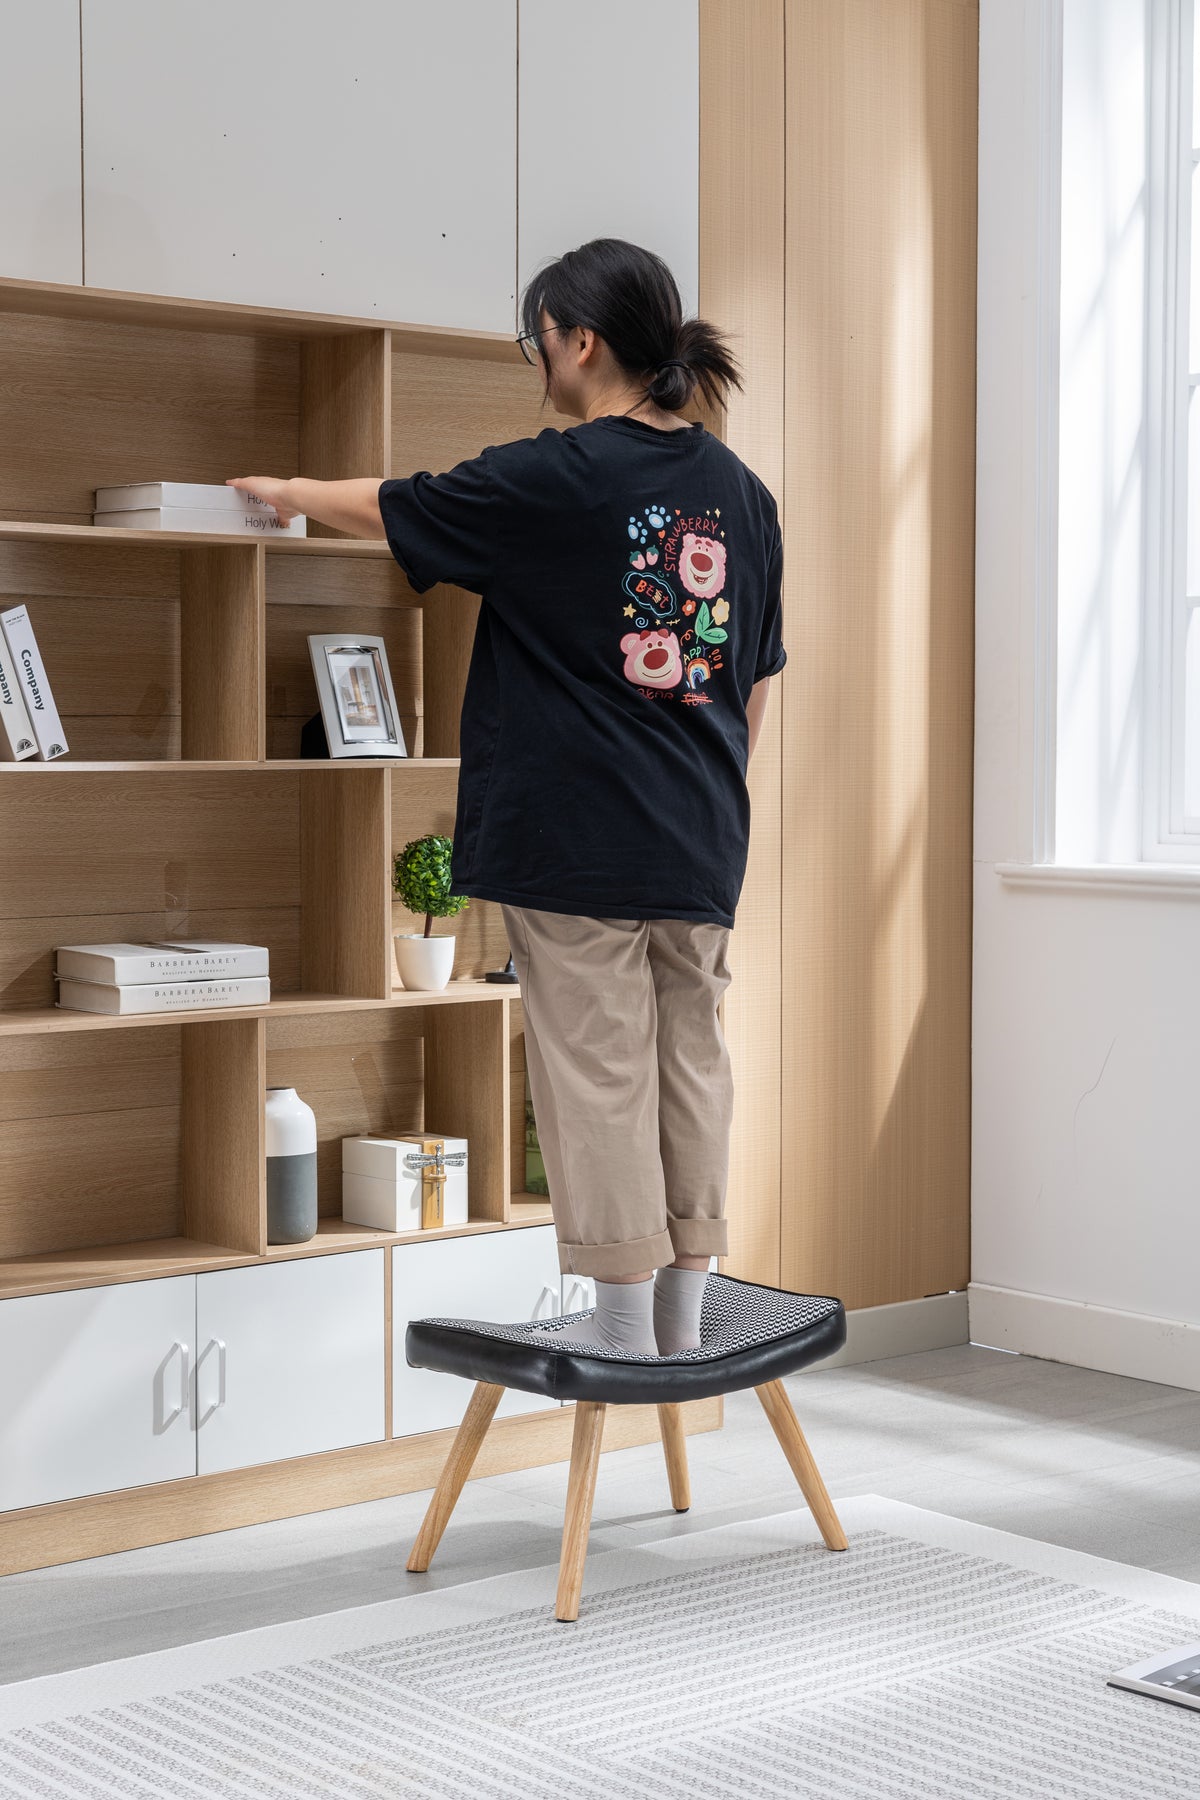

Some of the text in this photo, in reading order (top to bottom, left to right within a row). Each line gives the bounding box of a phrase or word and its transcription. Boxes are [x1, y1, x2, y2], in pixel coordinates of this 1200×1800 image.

[245, 516, 267, 530] Holy
[664, 516, 719, 572] STRAWBERRY
[21, 649, 45, 711] Company
